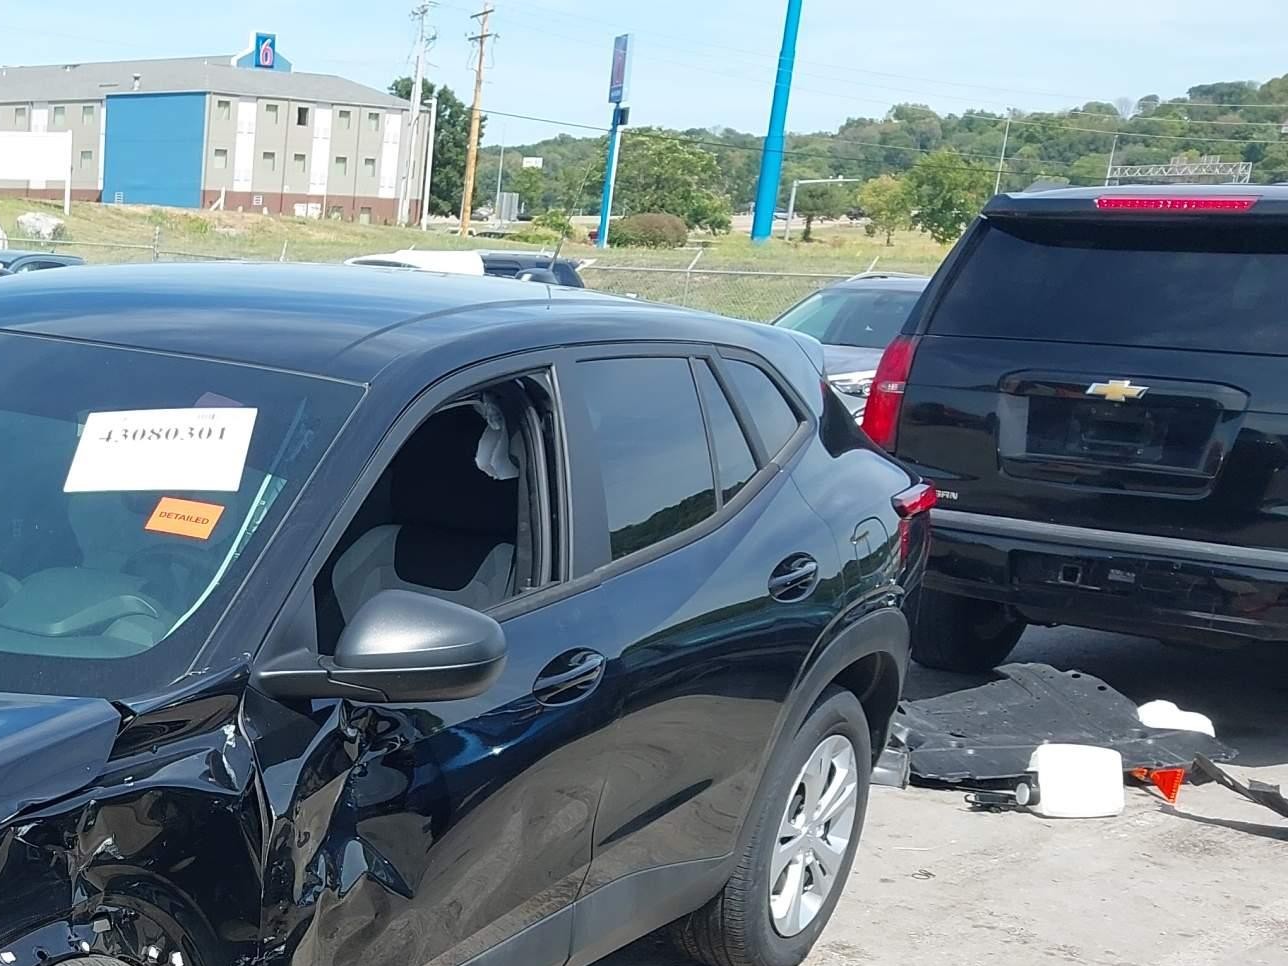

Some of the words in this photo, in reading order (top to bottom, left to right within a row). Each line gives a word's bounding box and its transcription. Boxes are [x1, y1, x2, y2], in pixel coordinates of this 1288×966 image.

[260, 38, 273, 66] 6
[98, 427, 226, 442] 43080301
[158, 511, 210, 526] DETAILED
